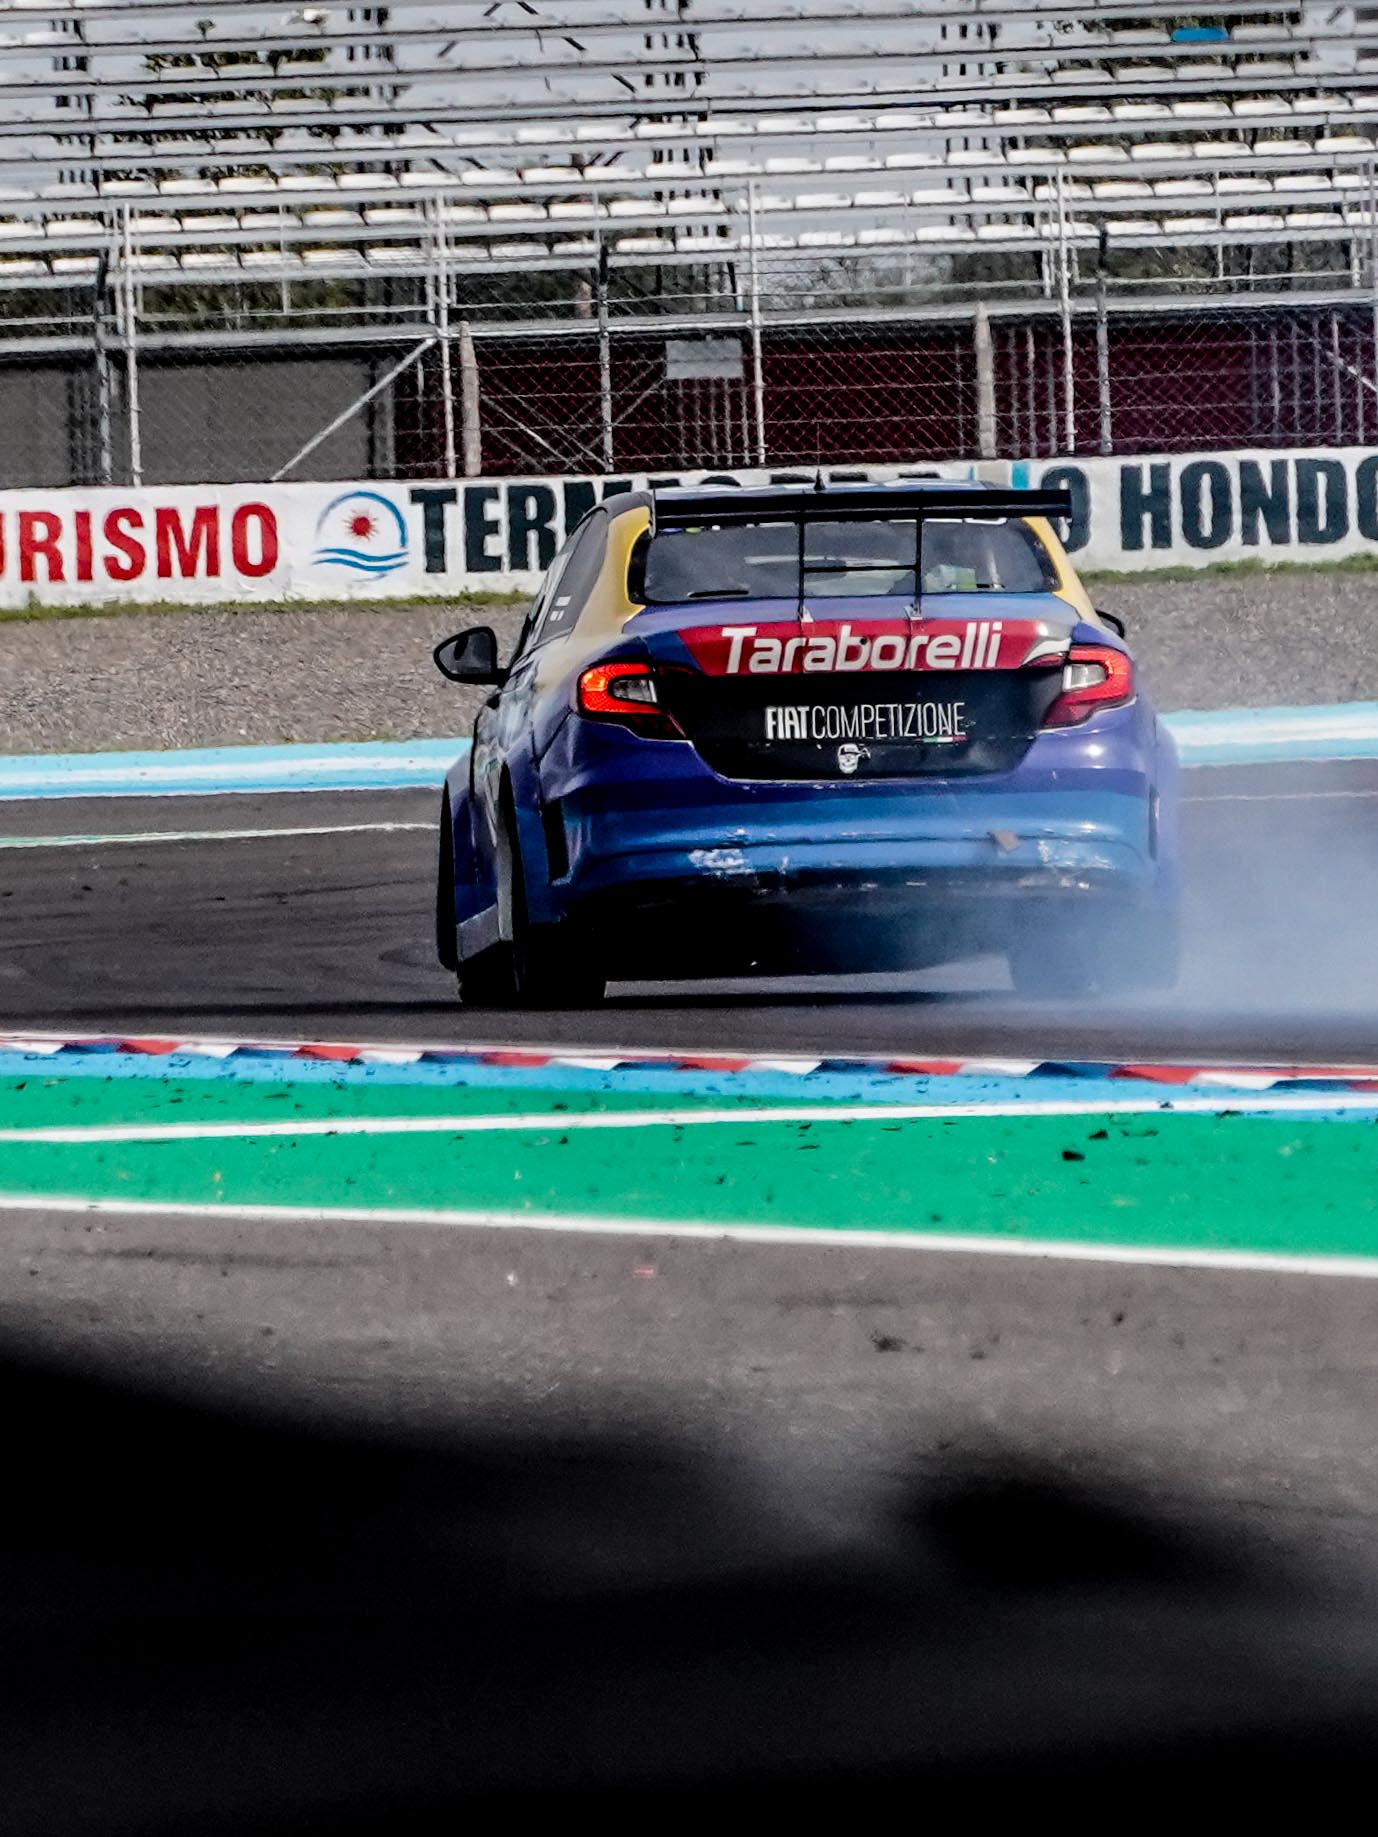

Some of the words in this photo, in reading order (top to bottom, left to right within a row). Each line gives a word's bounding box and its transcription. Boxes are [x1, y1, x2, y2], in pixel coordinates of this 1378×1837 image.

[0, 502, 279, 583] RISMO
[720, 621, 1003, 674] Taraborelli
[766, 706, 810, 740] FIAT
[812, 702, 966, 740] COMPETIZIONE
